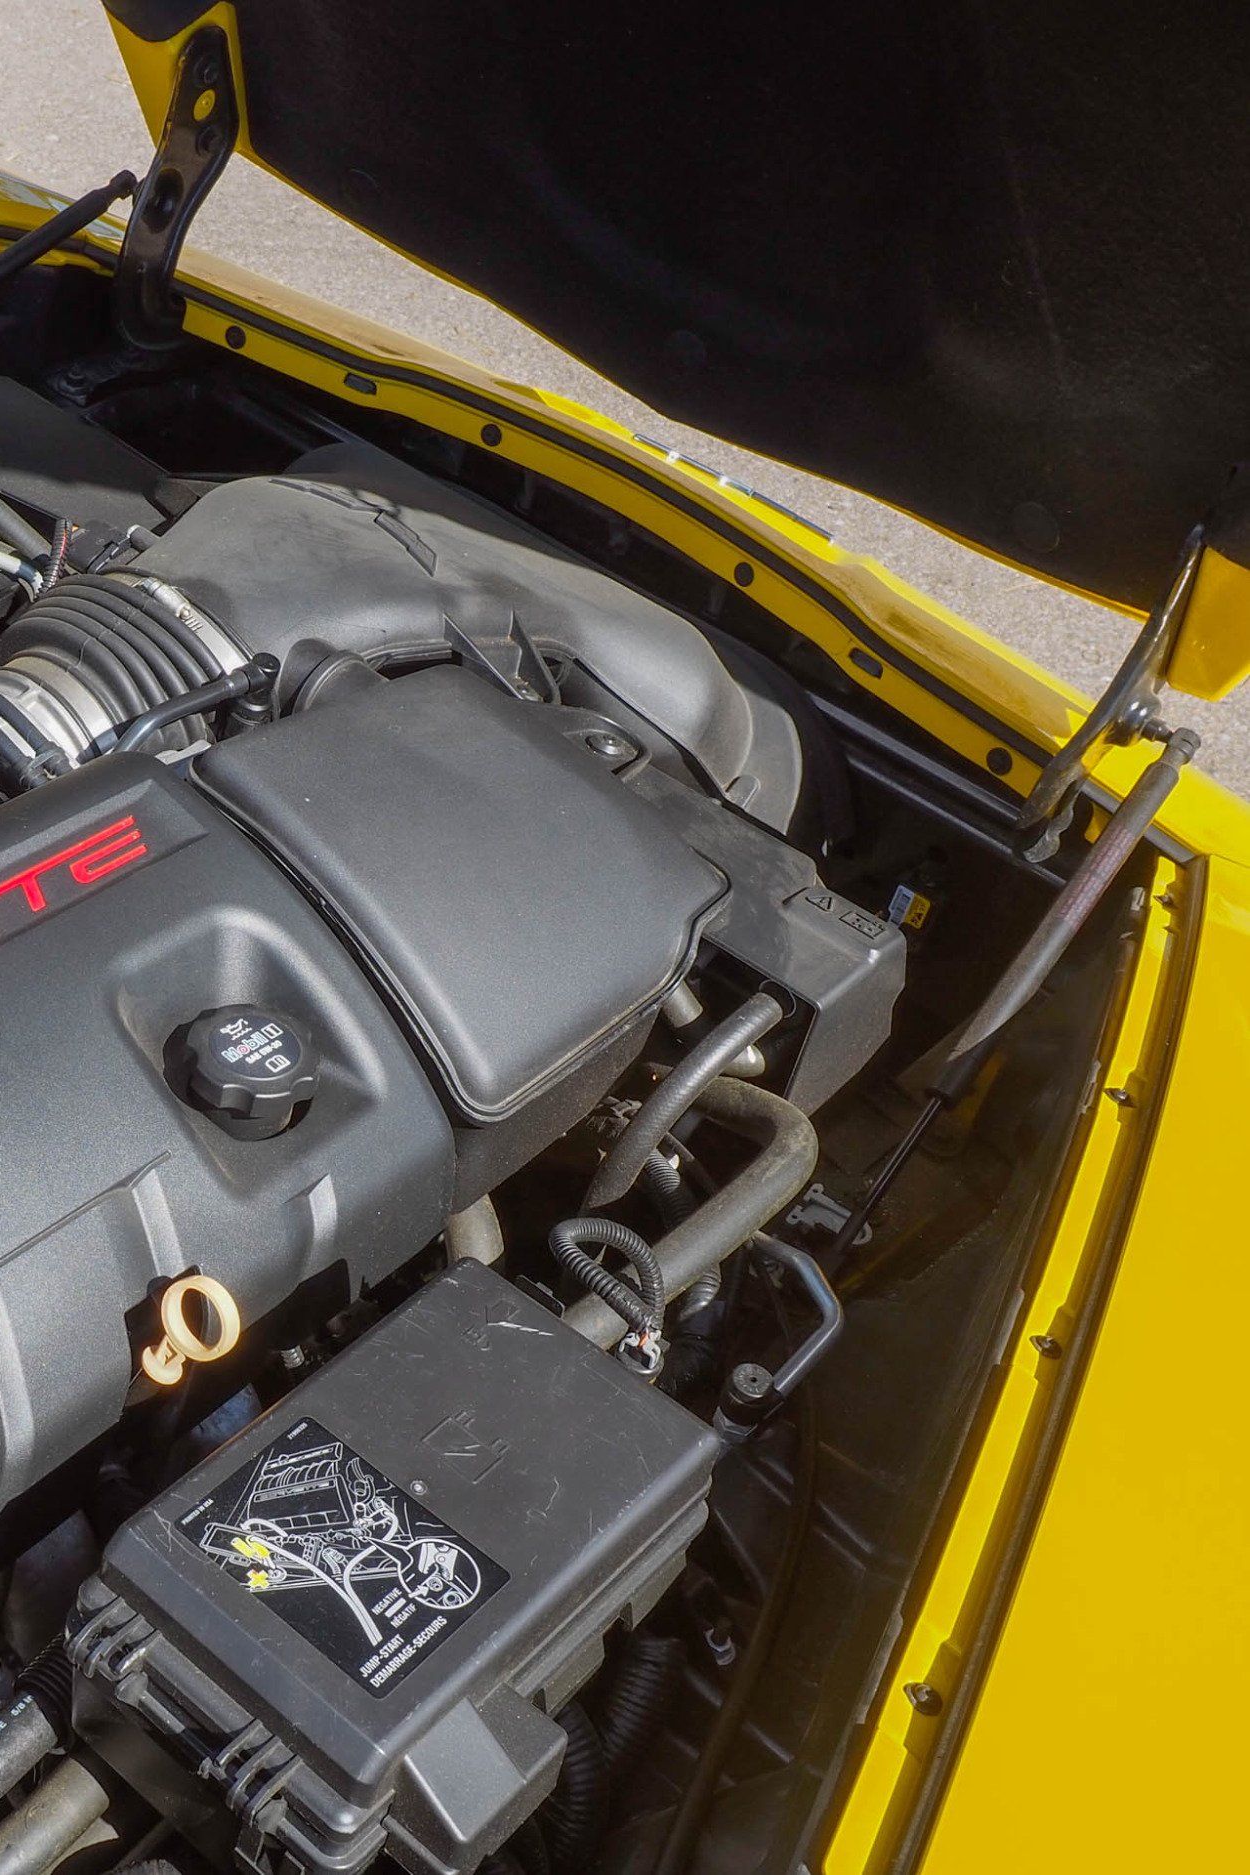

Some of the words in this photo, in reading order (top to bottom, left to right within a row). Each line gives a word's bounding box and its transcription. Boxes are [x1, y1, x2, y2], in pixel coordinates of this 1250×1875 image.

[221, 1031, 269, 1063] Mobil
[371, 1587, 403, 1615] NEGATIVE
[359, 1634, 404, 1678] JUMP-START
